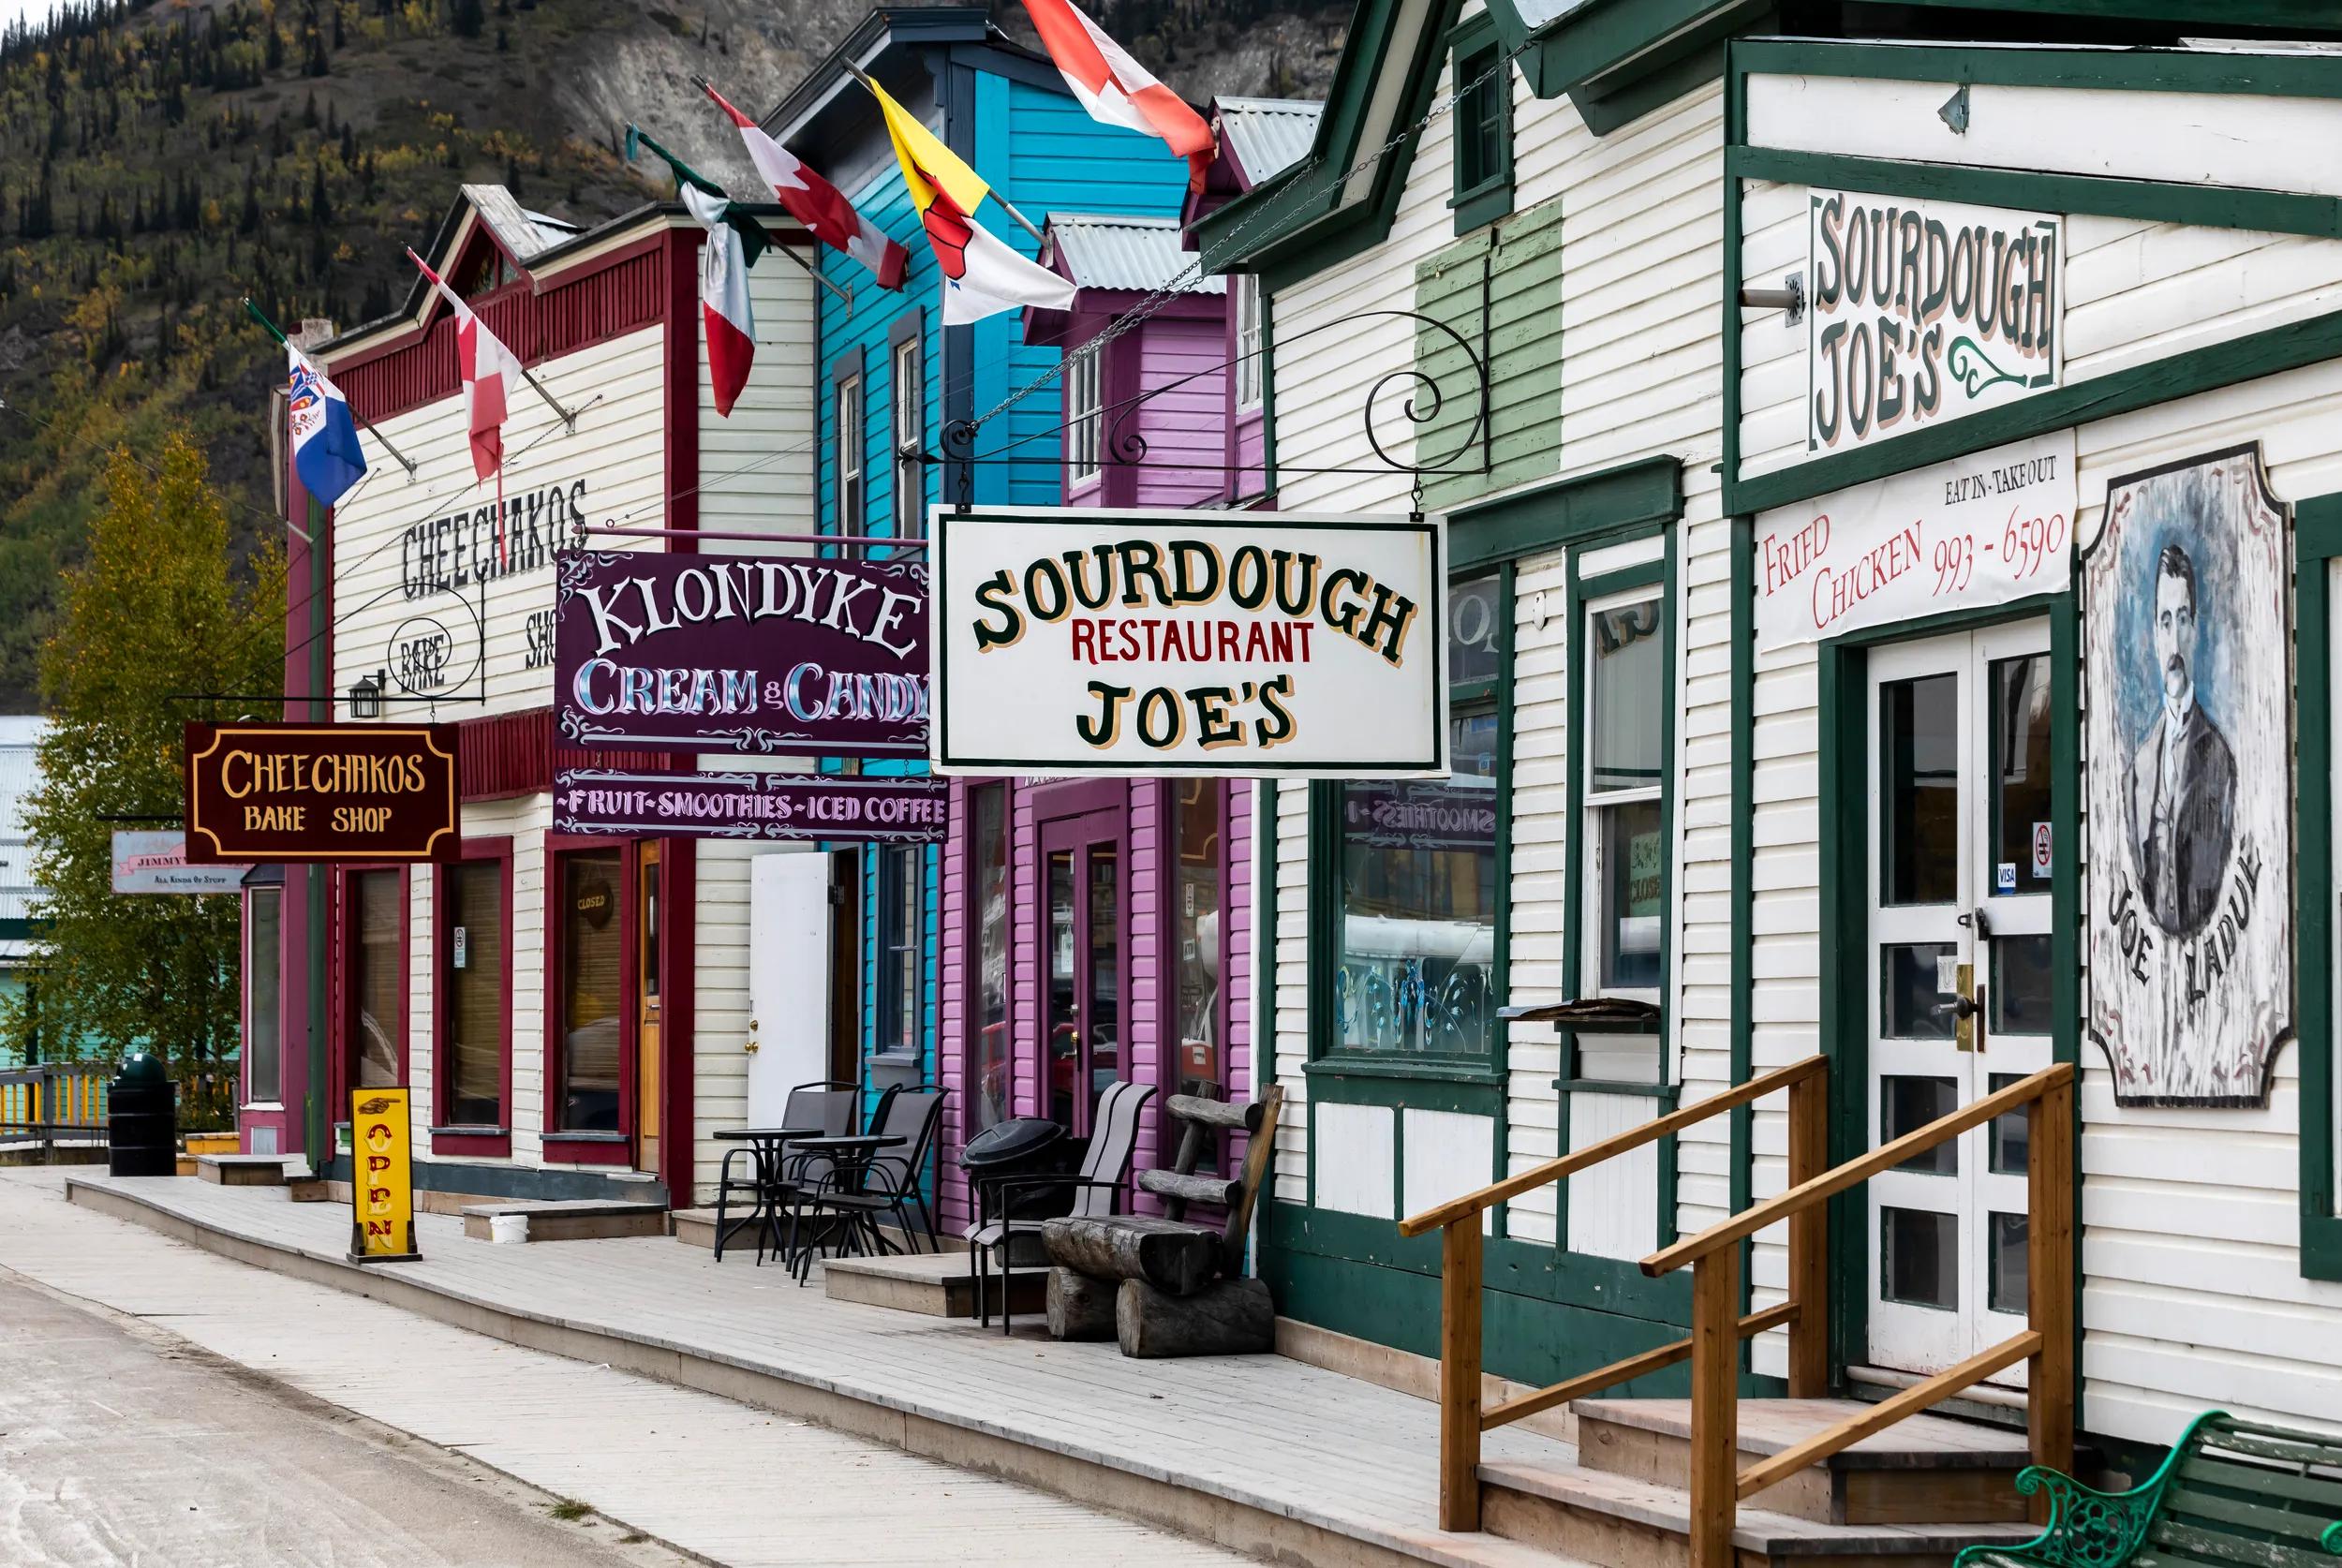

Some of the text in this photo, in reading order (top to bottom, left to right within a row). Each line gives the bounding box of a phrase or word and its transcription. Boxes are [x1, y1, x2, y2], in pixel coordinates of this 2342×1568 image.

[1816, 193, 2052, 359] SOURDOUGH
[1816, 316, 1943, 448] JOE'S
[1945, 477, 1970, 506] EAT
[1971, 474, 1987, 500] IN
[403, 479, 587, 601] CHEECHAKOS
[1763, 514, 1831, 598] FRIED
[1812, 519, 1922, 629] CHICKEN
[1933, 534, 1973, 597] 993
[2003, 504, 2065, 581] 6590
[574, 560, 922, 660] KLONDYKE
[972, 540, 1419, 669] SOURDOUGH
[1071, 618, 1314, 664] RESTAURANT
[401, 609, 556, 693] BAKE SHO
[573, 658, 760, 717] CREAM
[1075, 673, 1297, 751] JOE'S
[221, 749, 426, 799] CHEECHAKOS
[864, 796, 946, 824] COFFEE
[244, 806, 393, 833] BAKE SHOP
[577, 895, 605, 910] CLOSED
[1998, 867, 2015, 883] VISA
[2108, 870, 2154, 987] JOE
[363, 1123, 394, 1251] OPEN
